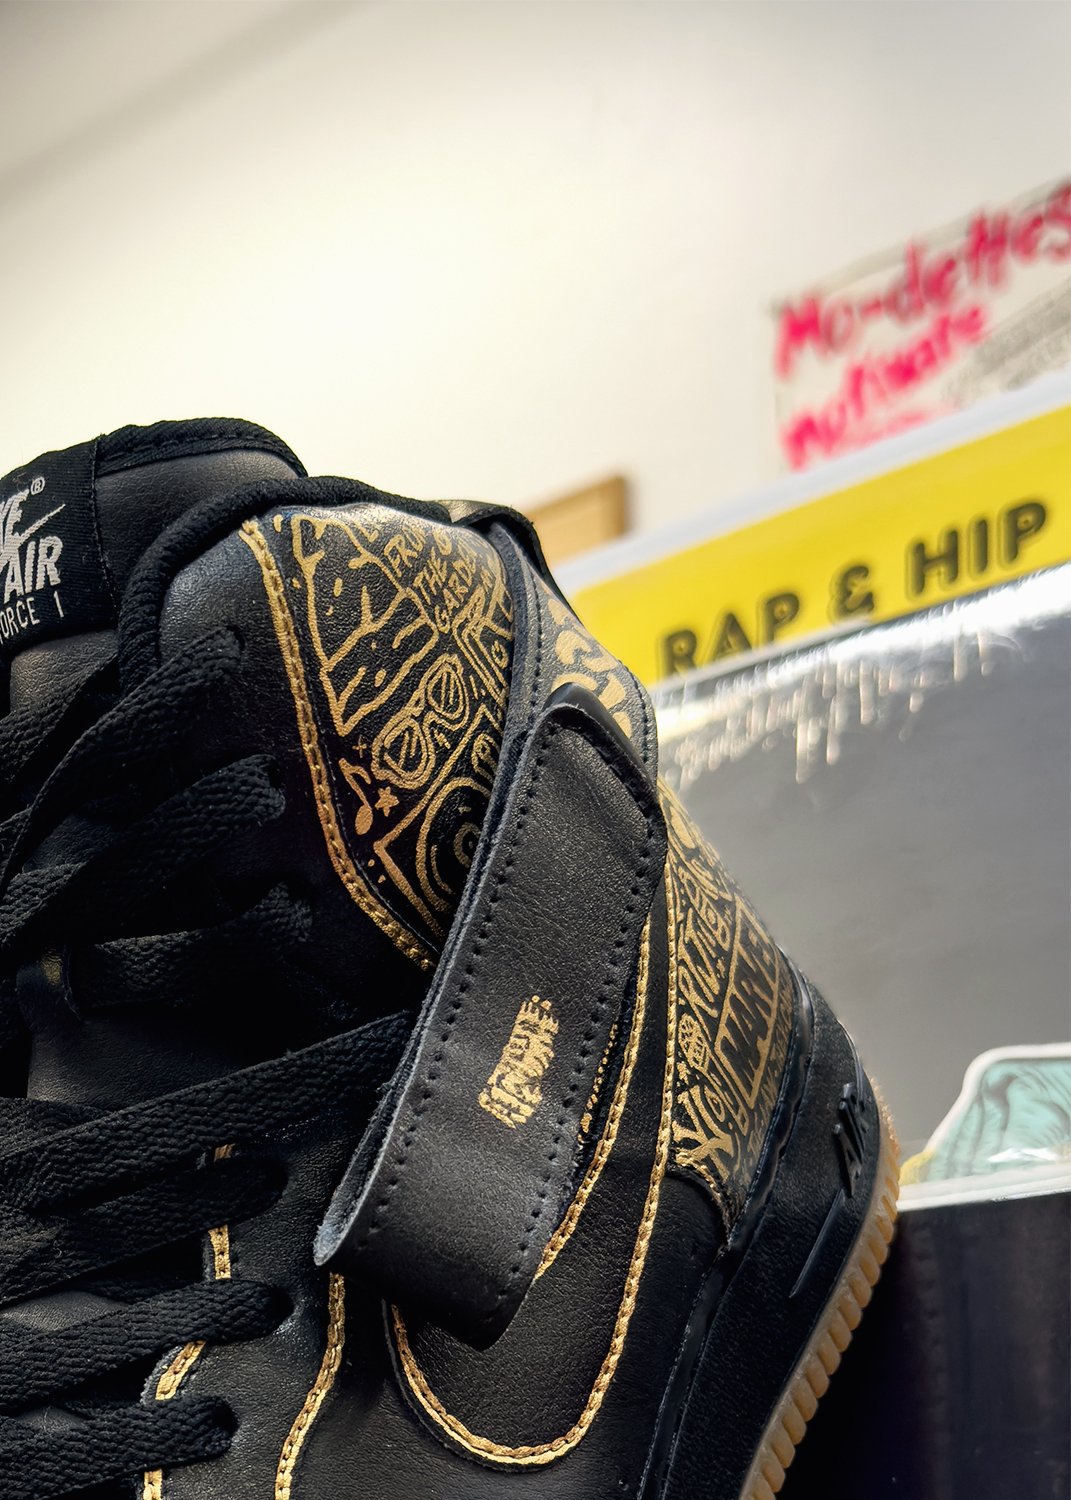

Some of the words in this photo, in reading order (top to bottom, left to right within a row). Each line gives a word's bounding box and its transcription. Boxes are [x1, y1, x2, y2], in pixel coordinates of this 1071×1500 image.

[3, 536, 64, 604] AIR
[662, 590, 800, 682] RAP
[836, 562, 876, 620] &
[908, 500, 1049, 598] HIP
